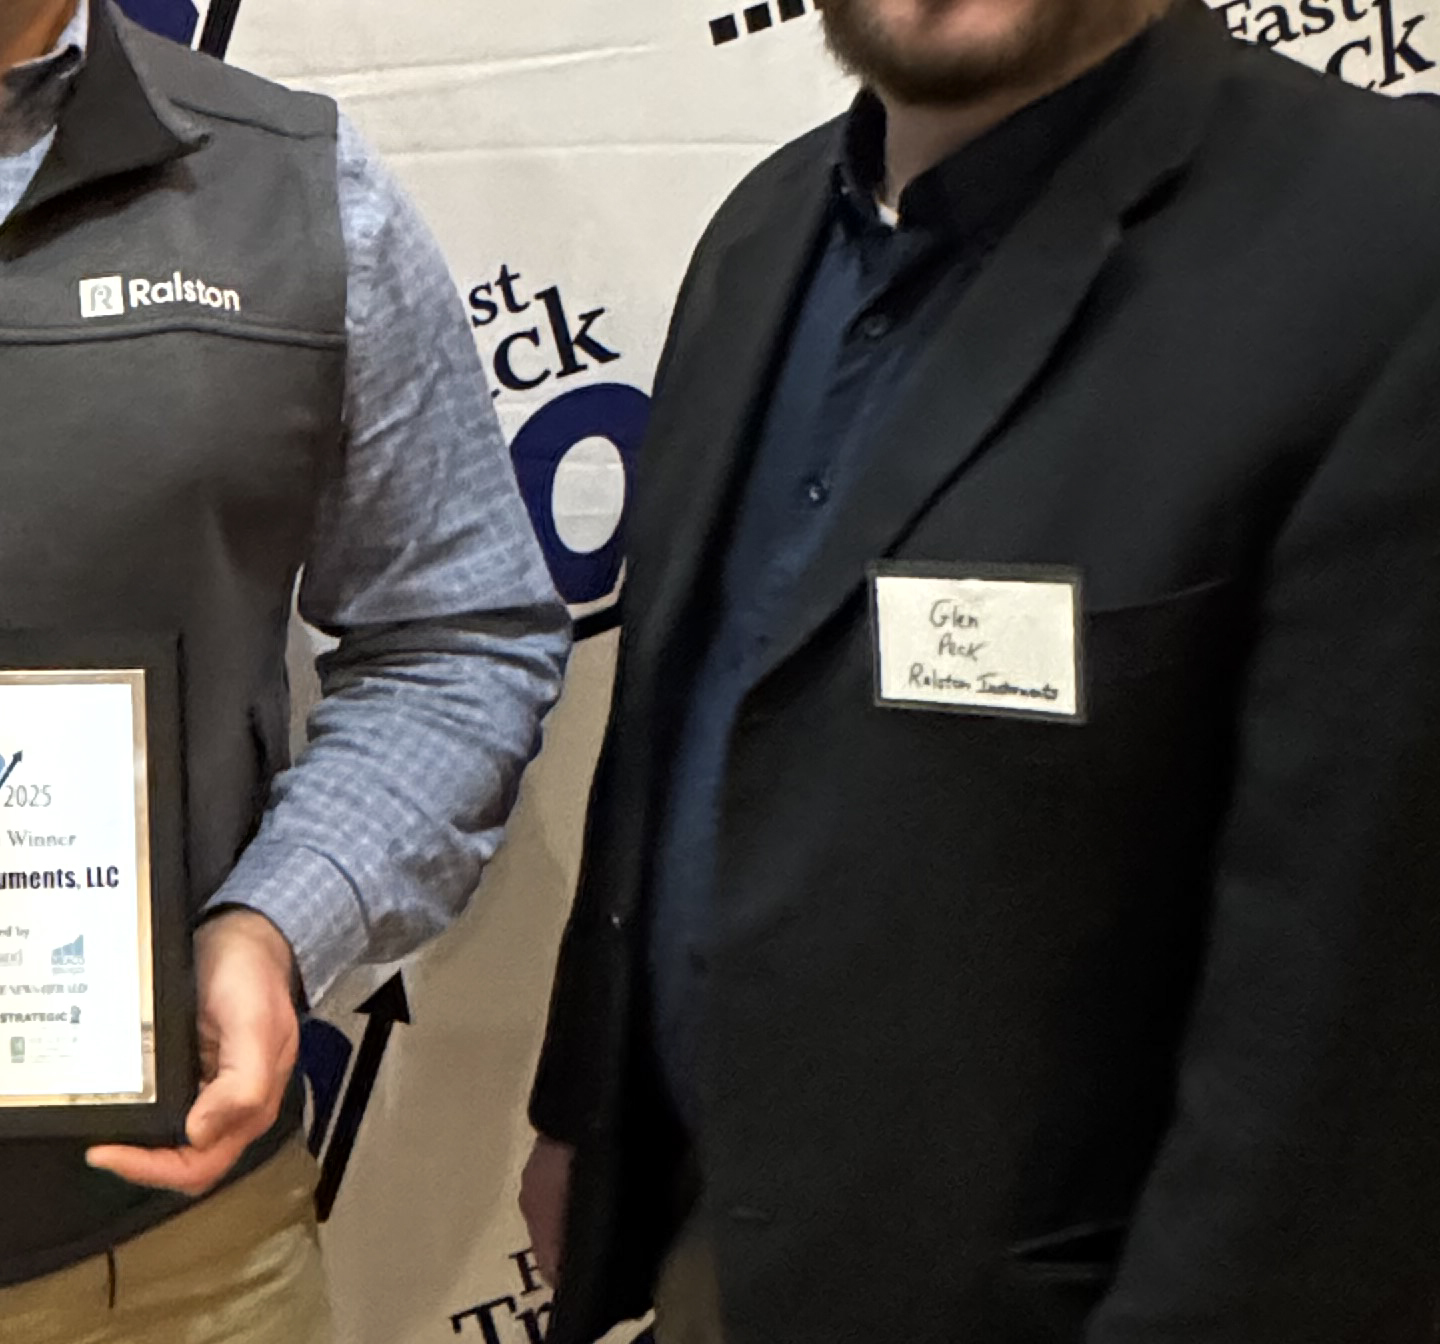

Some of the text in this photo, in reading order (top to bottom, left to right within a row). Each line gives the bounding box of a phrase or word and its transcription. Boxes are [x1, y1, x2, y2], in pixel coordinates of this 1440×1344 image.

[128, 271, 241, 312] Ralston
[468, 264, 531, 328] st
[3, 784, 52, 808] 2025
[7, 829, 77, 848] Winner
[86, 865, 120, 888] LLC
